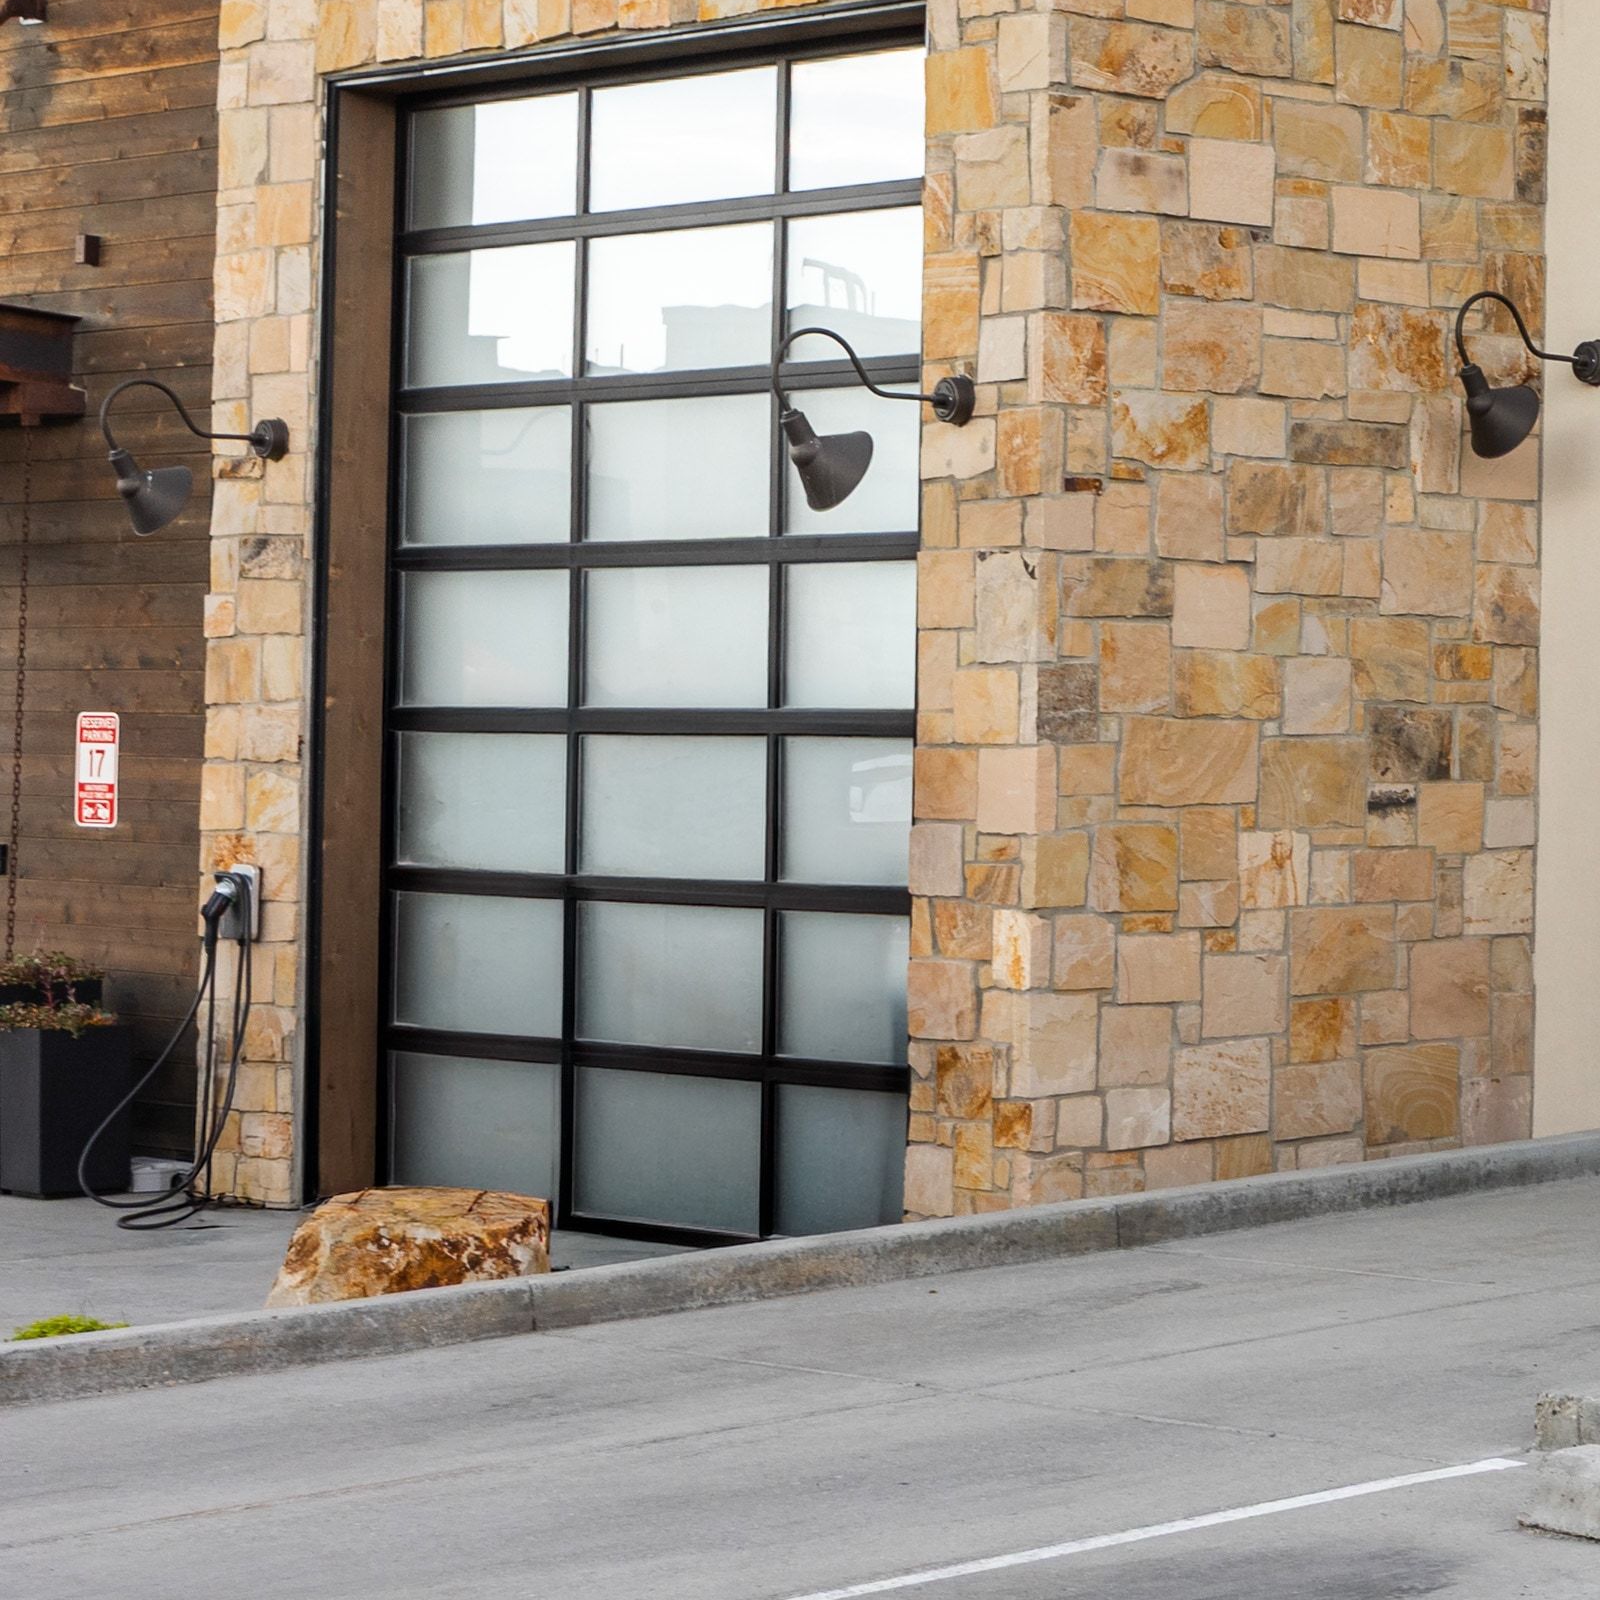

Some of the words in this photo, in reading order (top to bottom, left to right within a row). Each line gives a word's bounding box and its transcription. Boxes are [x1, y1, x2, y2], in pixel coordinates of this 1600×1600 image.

[80, 717, 116, 728] RESERVED
[81, 729, 115, 742] PARKING
[89, 749, 105, 777] 17
